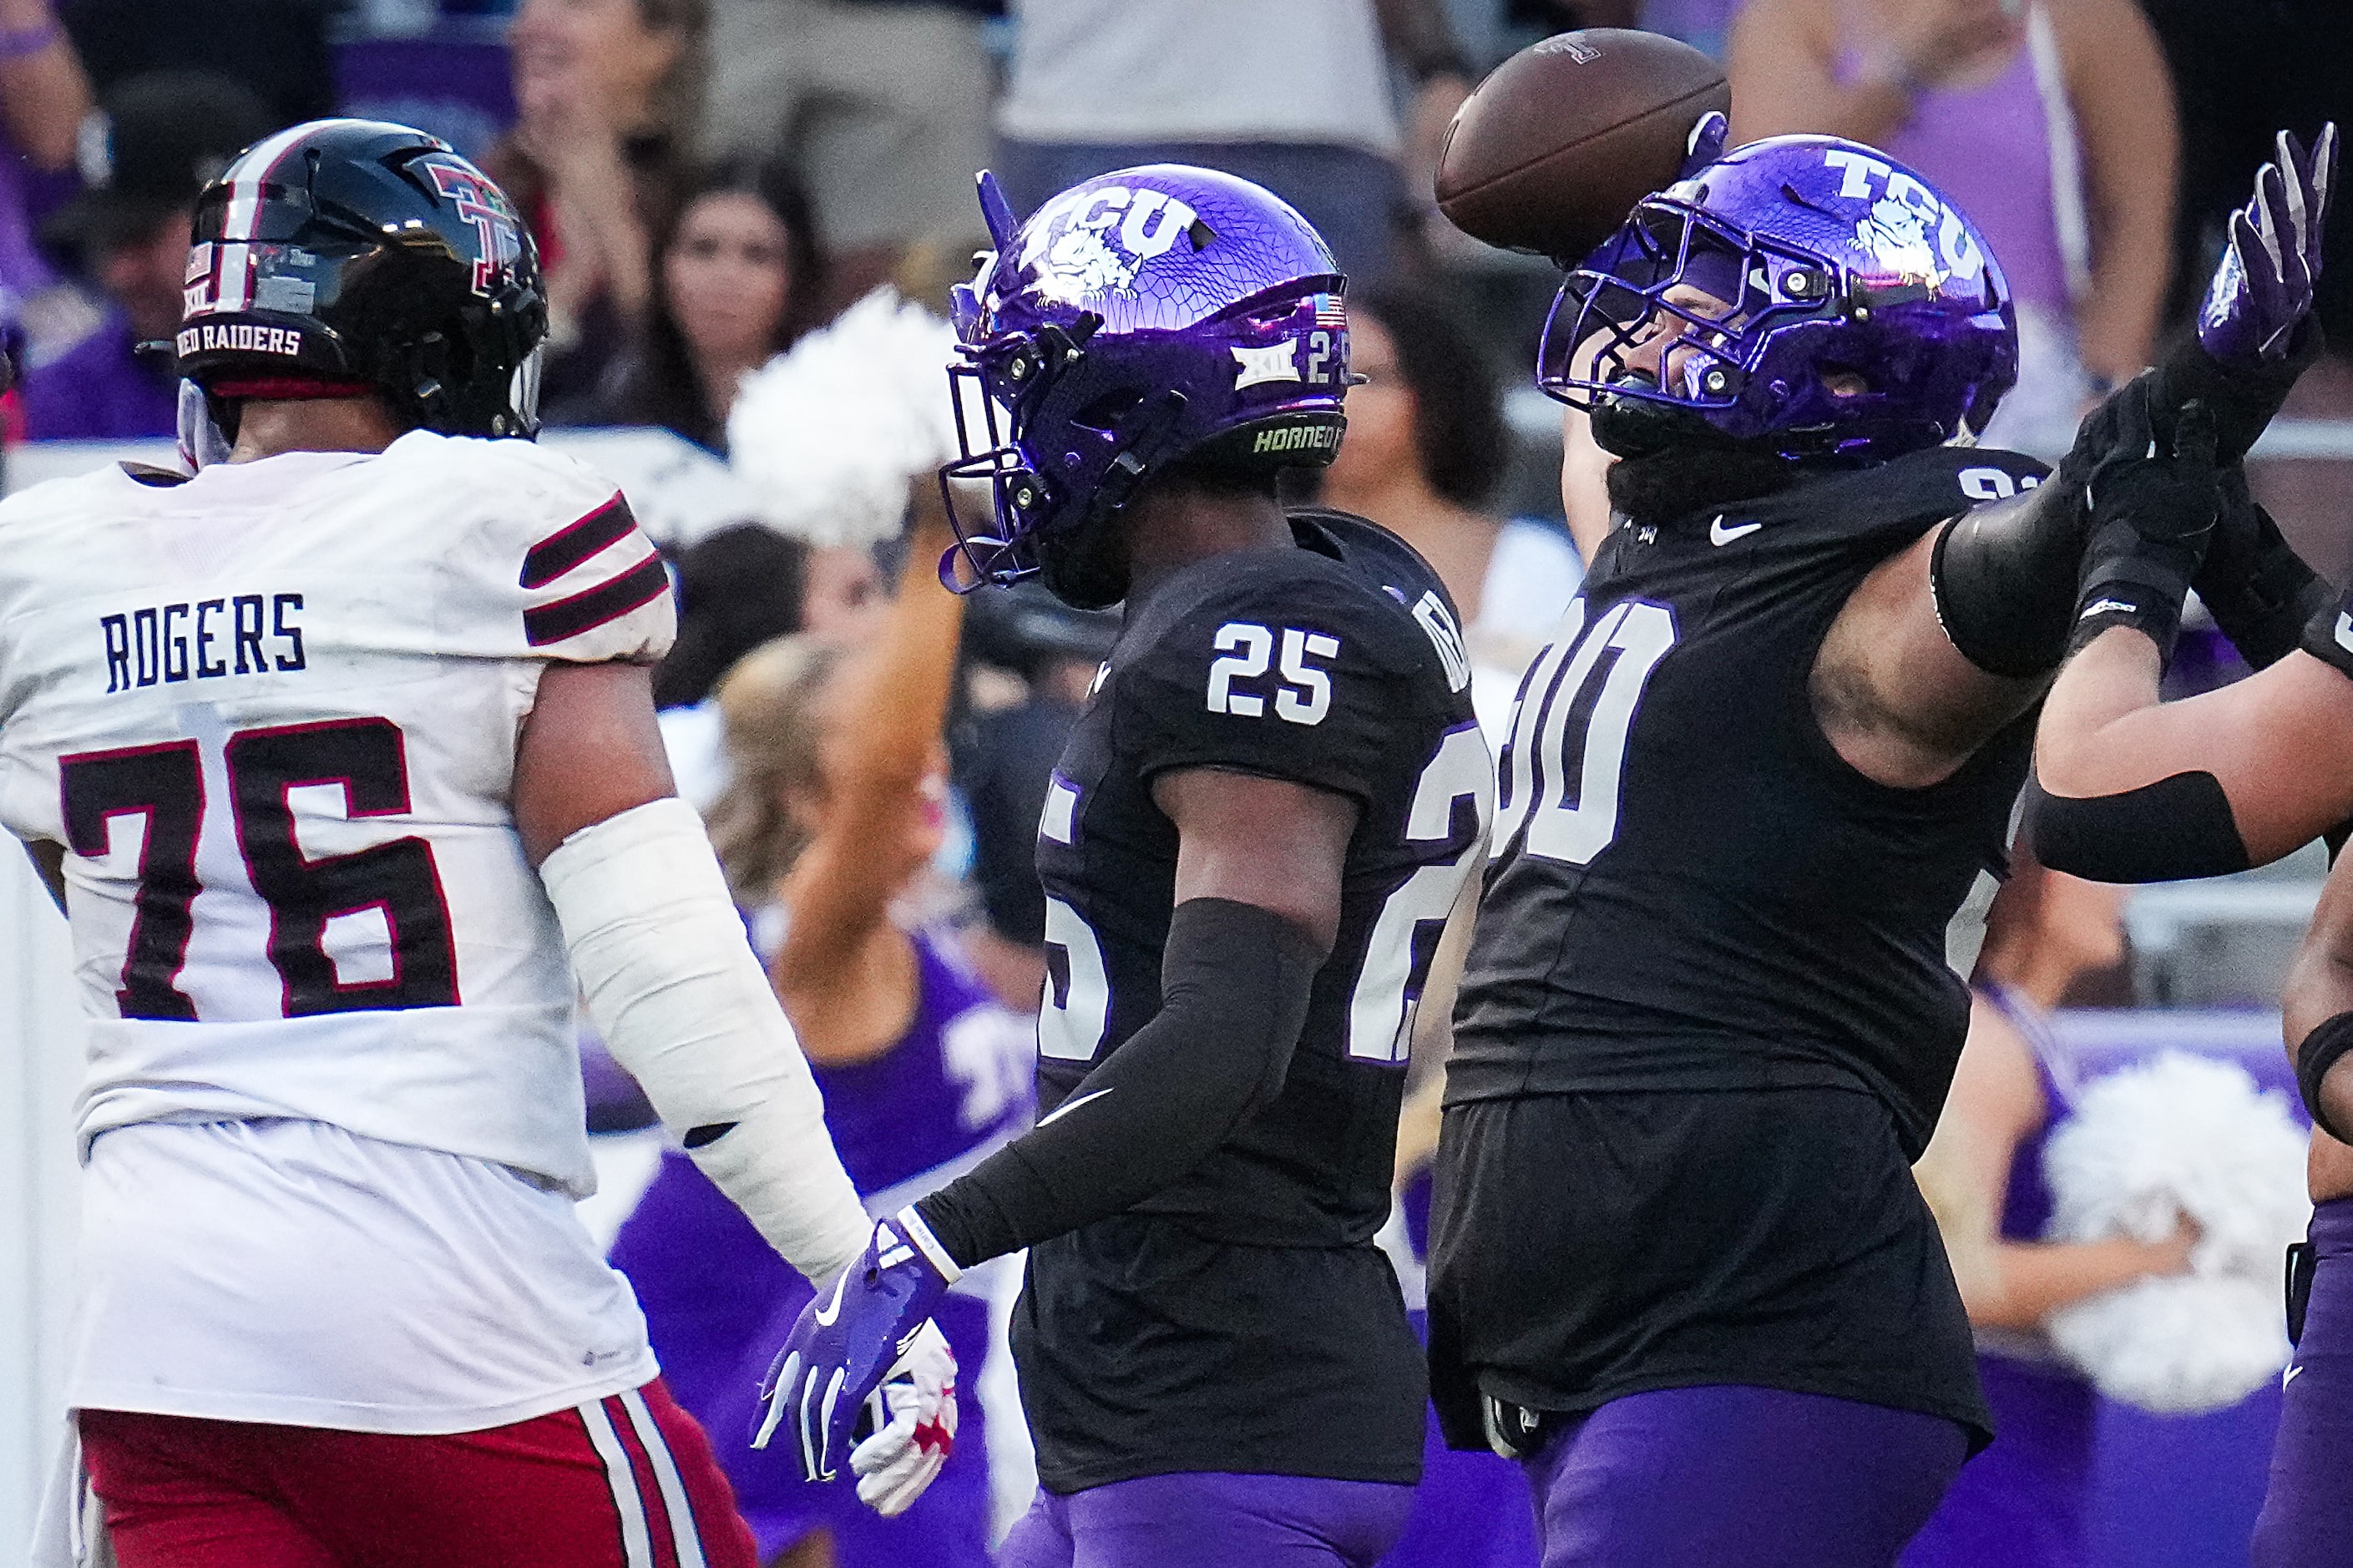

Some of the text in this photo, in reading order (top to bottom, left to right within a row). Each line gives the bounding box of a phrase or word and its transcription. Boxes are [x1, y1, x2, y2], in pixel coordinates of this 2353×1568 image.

[1017, 185, 1199, 274] TCU
[1824, 149, 1985, 281] TCU
[203, 324, 301, 356] RAIDERS
[100, 593, 306, 694] ROGERS
[1207, 622, 1340, 726] 25
[58, 716, 463, 1022] 76
